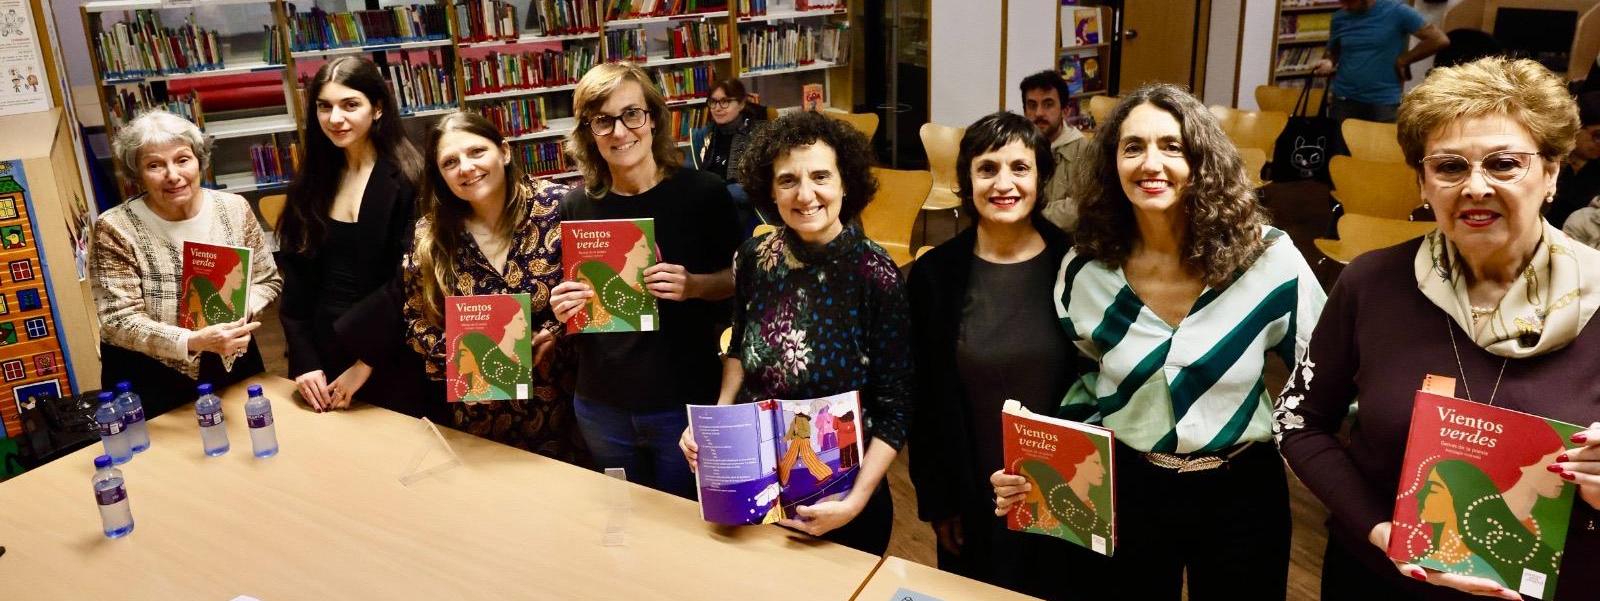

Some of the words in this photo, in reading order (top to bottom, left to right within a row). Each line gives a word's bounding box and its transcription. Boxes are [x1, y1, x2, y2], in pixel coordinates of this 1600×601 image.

[571, 228, 611, 239] Vientos
[576, 238, 610, 249] verdes
[190, 247, 217, 260] Vientos
[192, 258, 216, 268] verdes
[456, 303, 492, 312] Vientos
[460, 312, 490, 322] verdes
[1437, 405, 1504, 434] Vientos
[1013, 422, 1058, 442] Vientos
[1440, 426, 1497, 448] verdes
[1019, 438, 1057, 452] verdes
